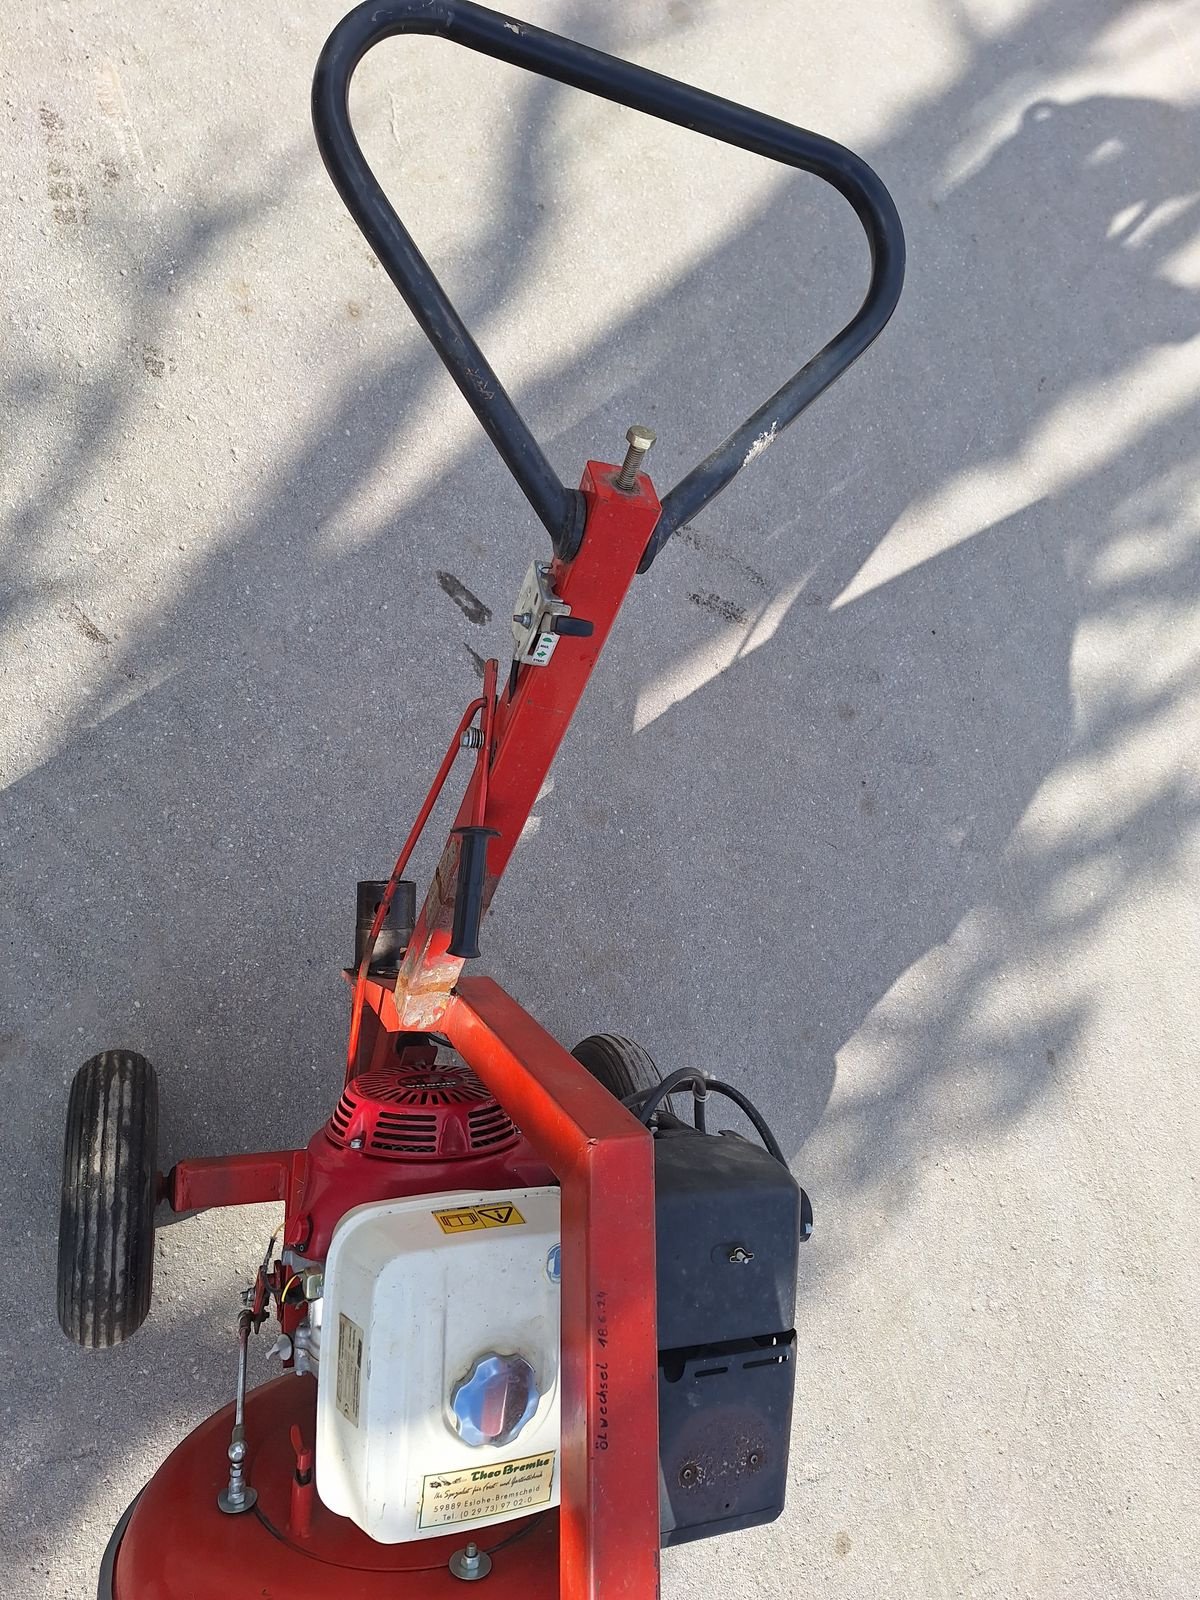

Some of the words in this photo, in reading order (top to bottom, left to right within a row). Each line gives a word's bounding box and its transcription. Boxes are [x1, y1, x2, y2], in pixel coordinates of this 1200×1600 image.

[471, 1470, 501, 1482] Theo
[503, 1459, 550, 1475] Bremke
[434, 1502, 461, 1513] 59889
[471, 1506, 482, 1516] 29
[484, 1503, 498, 1515] 73)
[501, 1501, 511, 1509] 97
